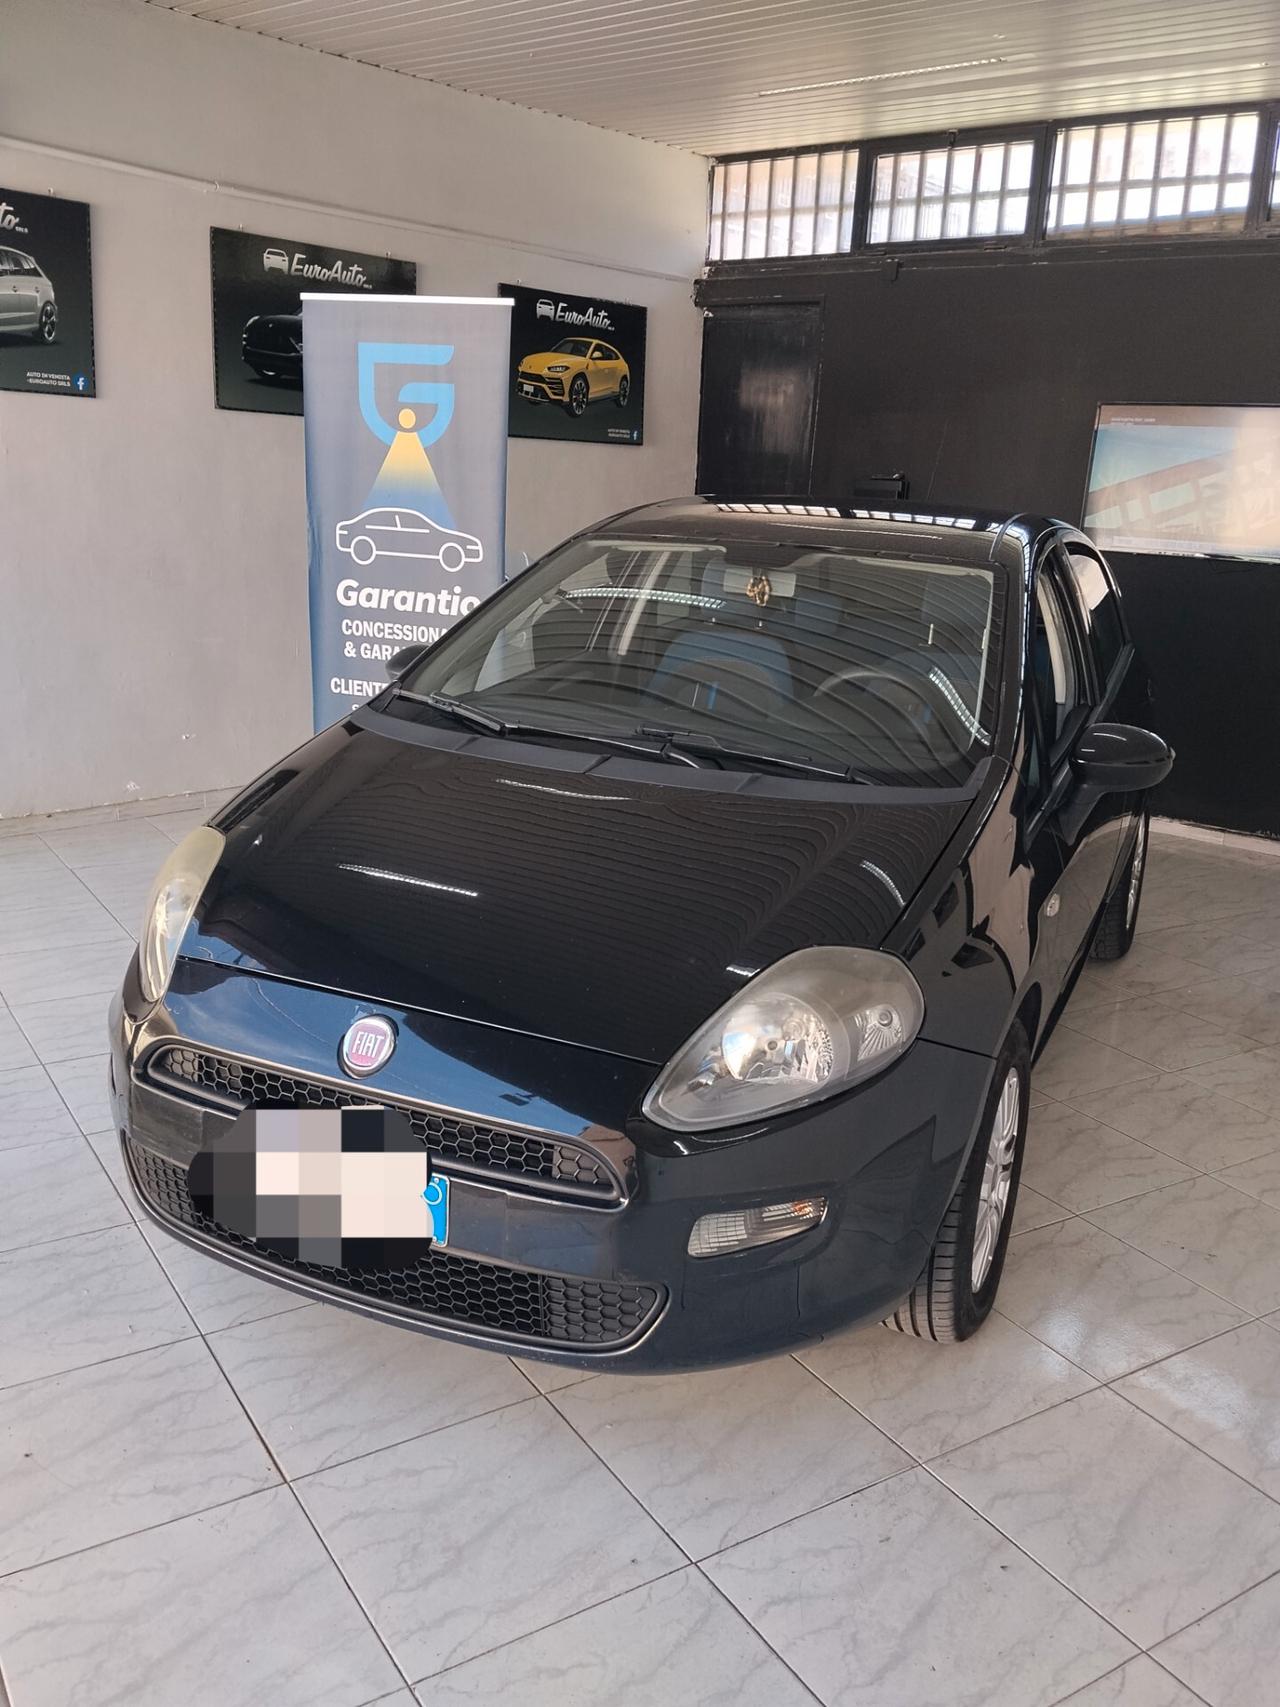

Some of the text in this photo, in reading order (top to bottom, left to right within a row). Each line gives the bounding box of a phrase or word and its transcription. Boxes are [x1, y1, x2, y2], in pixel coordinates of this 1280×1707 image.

[290, 252, 367, 287] EuroAuto
[555, 301, 611, 329] EuroAuto
[343, 640, 357, 659] &
[351, 1030, 386, 1059] FIAT
